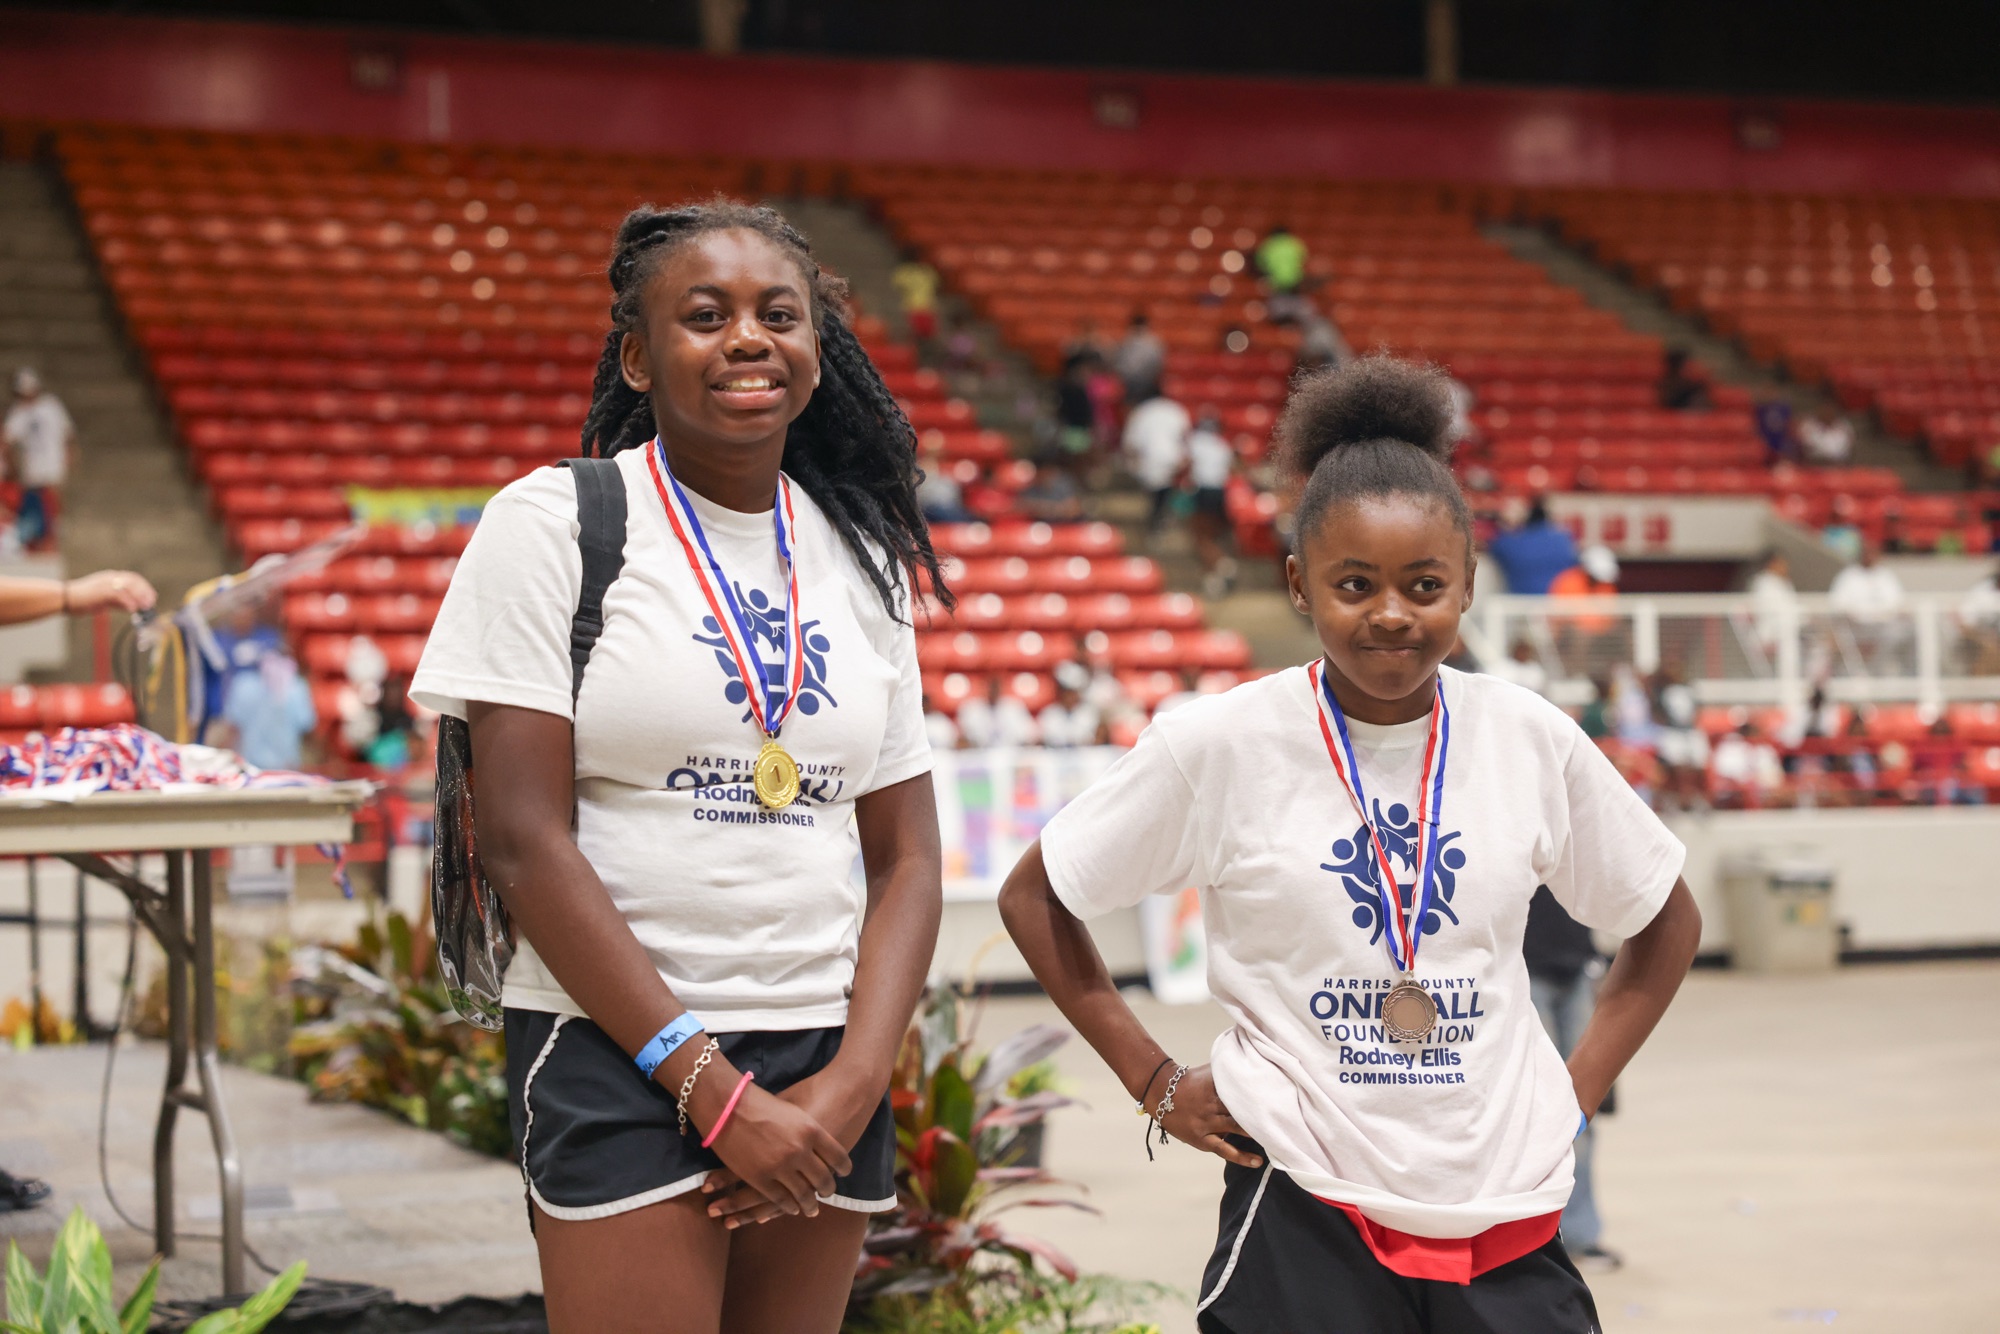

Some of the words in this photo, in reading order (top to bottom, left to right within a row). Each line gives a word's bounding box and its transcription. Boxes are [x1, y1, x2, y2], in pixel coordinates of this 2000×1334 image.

[769, 763, 781, 784] 1
[797, 762, 846, 776] OUNTY
[693, 808, 815, 827] COMMISSIONER
[1324, 978, 1391, 989] HARRIS
[1421, 978, 1476, 989] OUNTY
[1321, 1024, 1475, 1044] FOUNTION
[1339, 1046, 1415, 1070] Rodney
[1421, 1048, 1462, 1067] Ellis
[1339, 1072, 1466, 1085] COMMISSIONER
